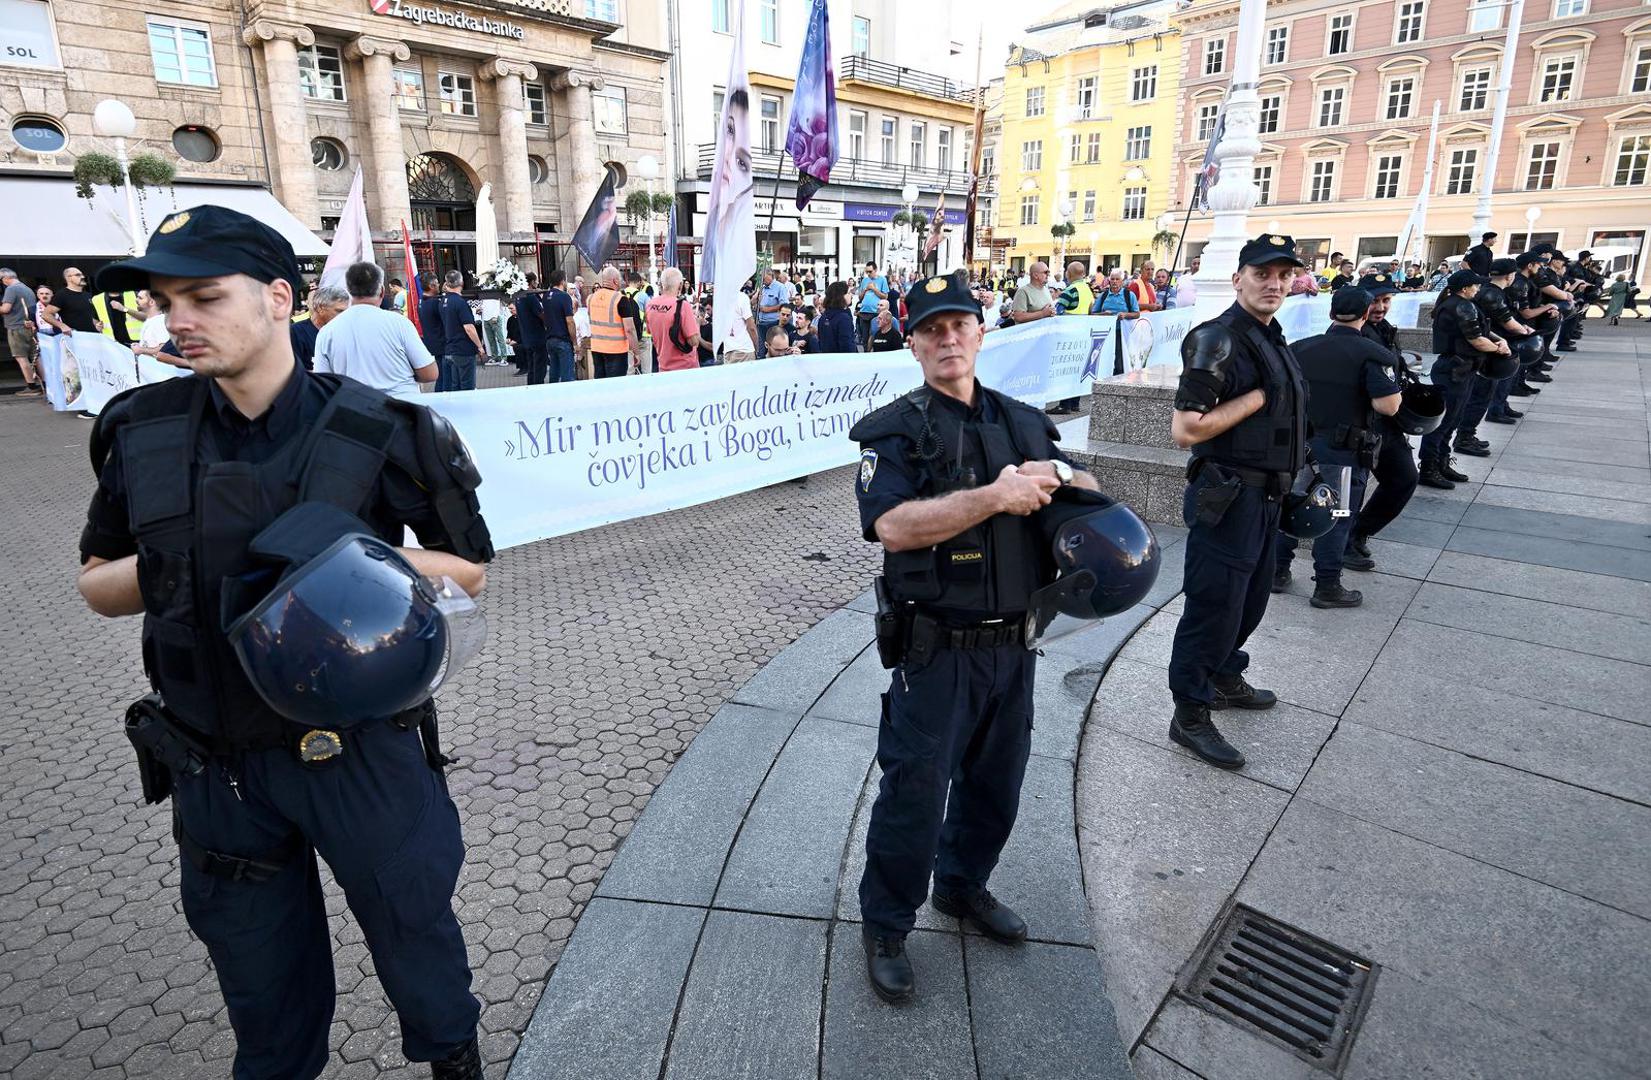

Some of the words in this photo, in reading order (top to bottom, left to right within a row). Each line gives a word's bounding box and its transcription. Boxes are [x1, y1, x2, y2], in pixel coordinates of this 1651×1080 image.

[391, 0, 479, 30] Zagrebačka
[482, 17, 525, 39] banka
[7, 46, 38, 59] SOL
[25, 129, 52, 139] SOL
[591, 410, 676, 446] mora
[683, 384, 798, 432] zavladati
[588, 436, 697, 490] čovjeka
[703, 430, 713, 462] i
[718, 419, 791, 461] Boga,
[797, 413, 805, 442] i
[951, 553, 982, 561] POLICIJA
